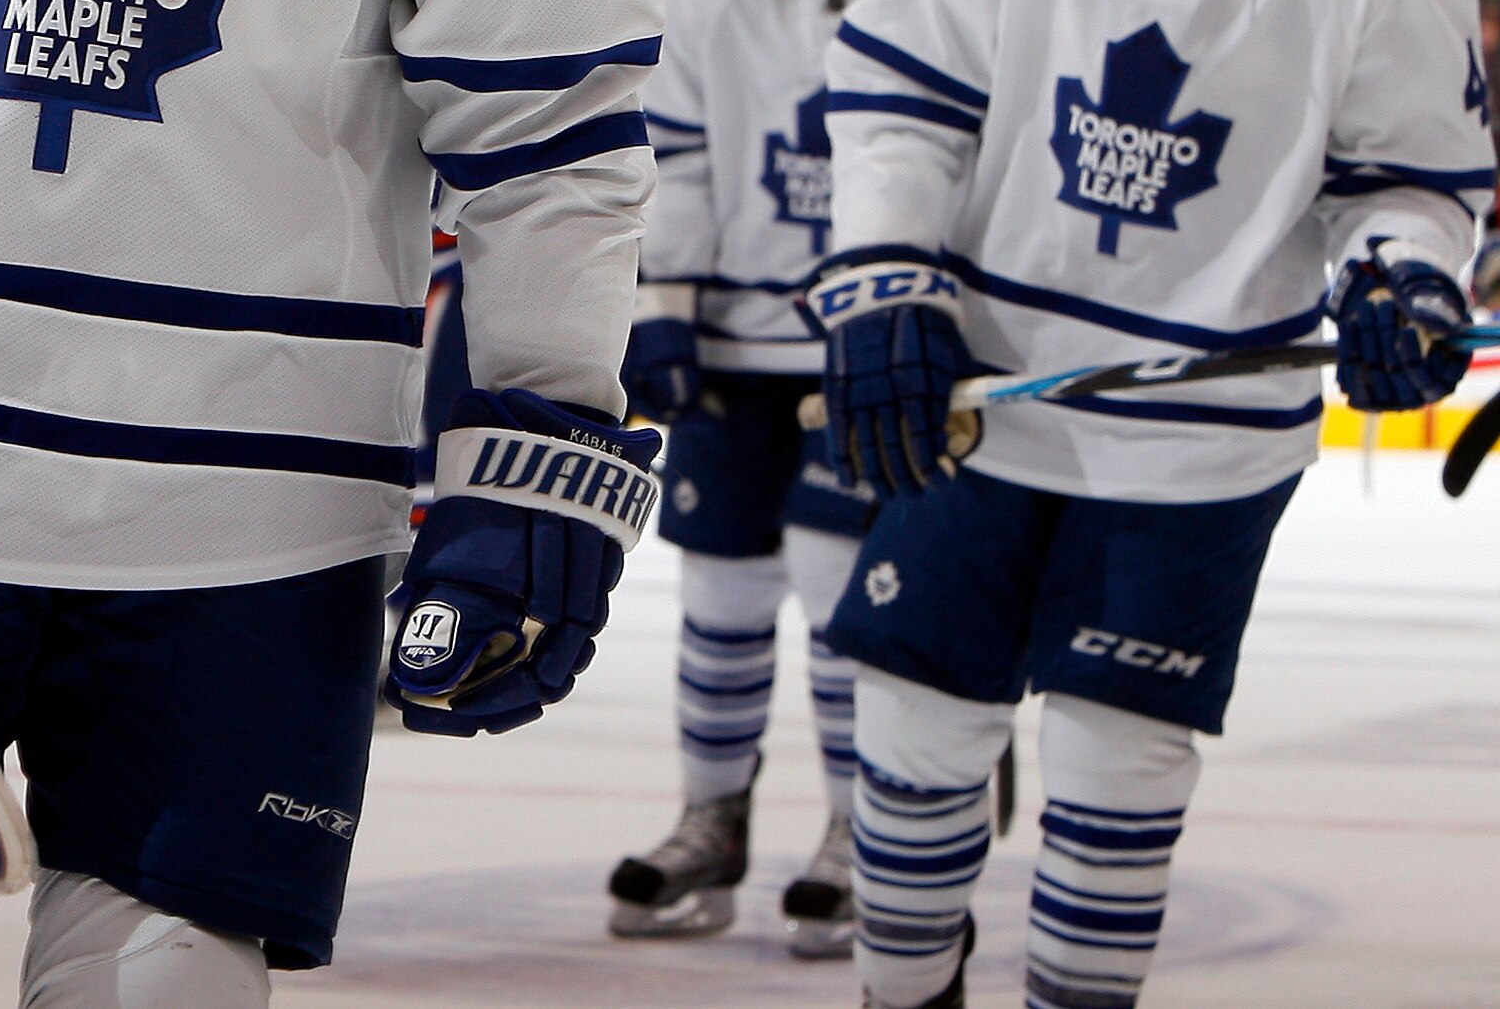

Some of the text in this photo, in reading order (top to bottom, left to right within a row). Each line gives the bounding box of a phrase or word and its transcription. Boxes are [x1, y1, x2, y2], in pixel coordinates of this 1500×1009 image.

[4, 32, 131, 90] LEAFS
[1068, 103, 1200, 167] TORONTO
[1076, 141, 1171, 190] MAPLE
[1077, 167, 1160, 215] LEAFS
[818, 271, 958, 318] CCM
[569, 428, 607, 452] KABA
[467, 437, 652, 531] WARR
[1069, 625, 1206, 679] CCM
